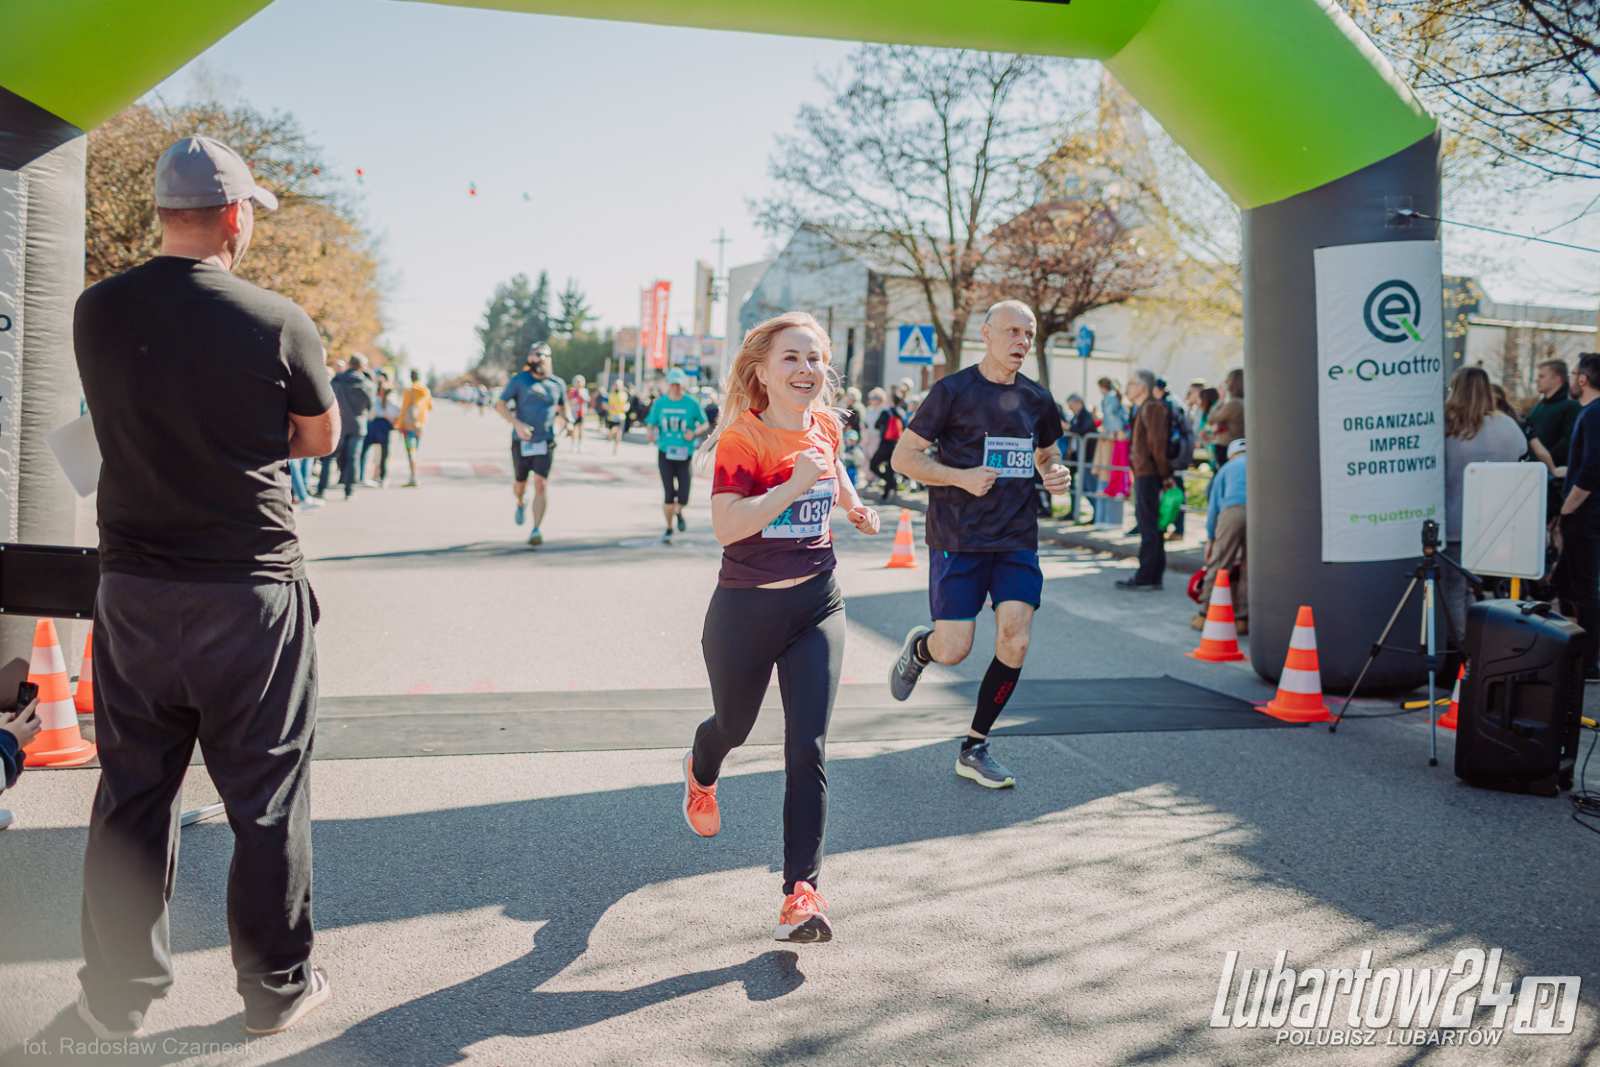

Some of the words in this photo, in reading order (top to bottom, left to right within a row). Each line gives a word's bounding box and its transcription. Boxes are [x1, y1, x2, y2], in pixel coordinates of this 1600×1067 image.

[1343, 411, 1435, 431] ORGANIZACJA
[1370, 435, 1420, 452] IMPREZ
[1007, 450, 1032, 468] 038
[1347, 456, 1436, 476] SPORTOWYCH
[799, 499, 829, 523] 039
